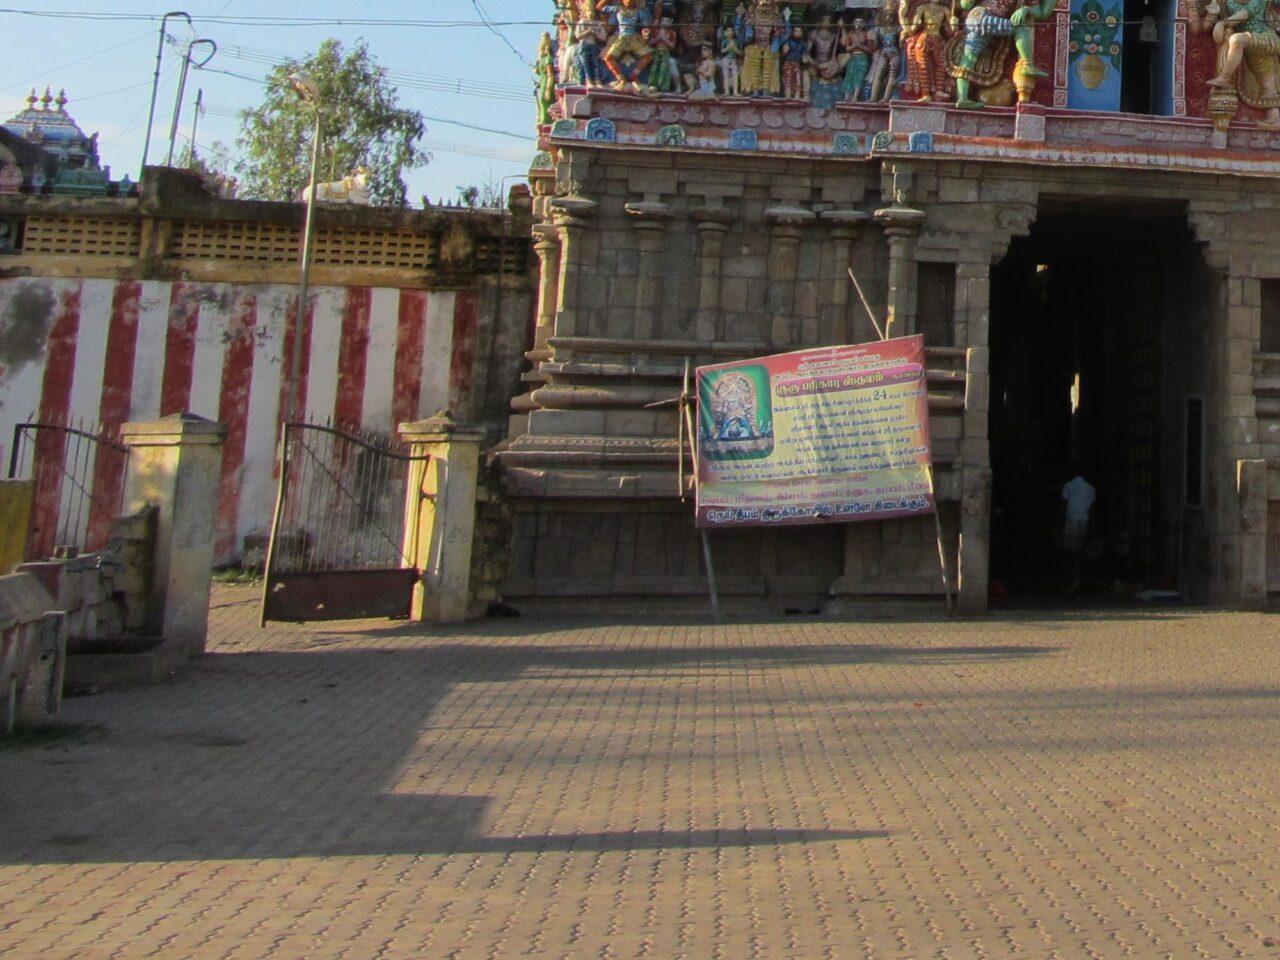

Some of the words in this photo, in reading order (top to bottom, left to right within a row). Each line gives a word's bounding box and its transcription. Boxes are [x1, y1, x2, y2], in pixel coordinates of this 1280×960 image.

[873, 390, 887, 400] 24
[708, 509, 735, 522] நெய்
[736, 507, 758, 522] தீபம்
[835, 501, 871, 515] உள்ளே
[874, 497, 930, 514] கிடைக்கும்.
